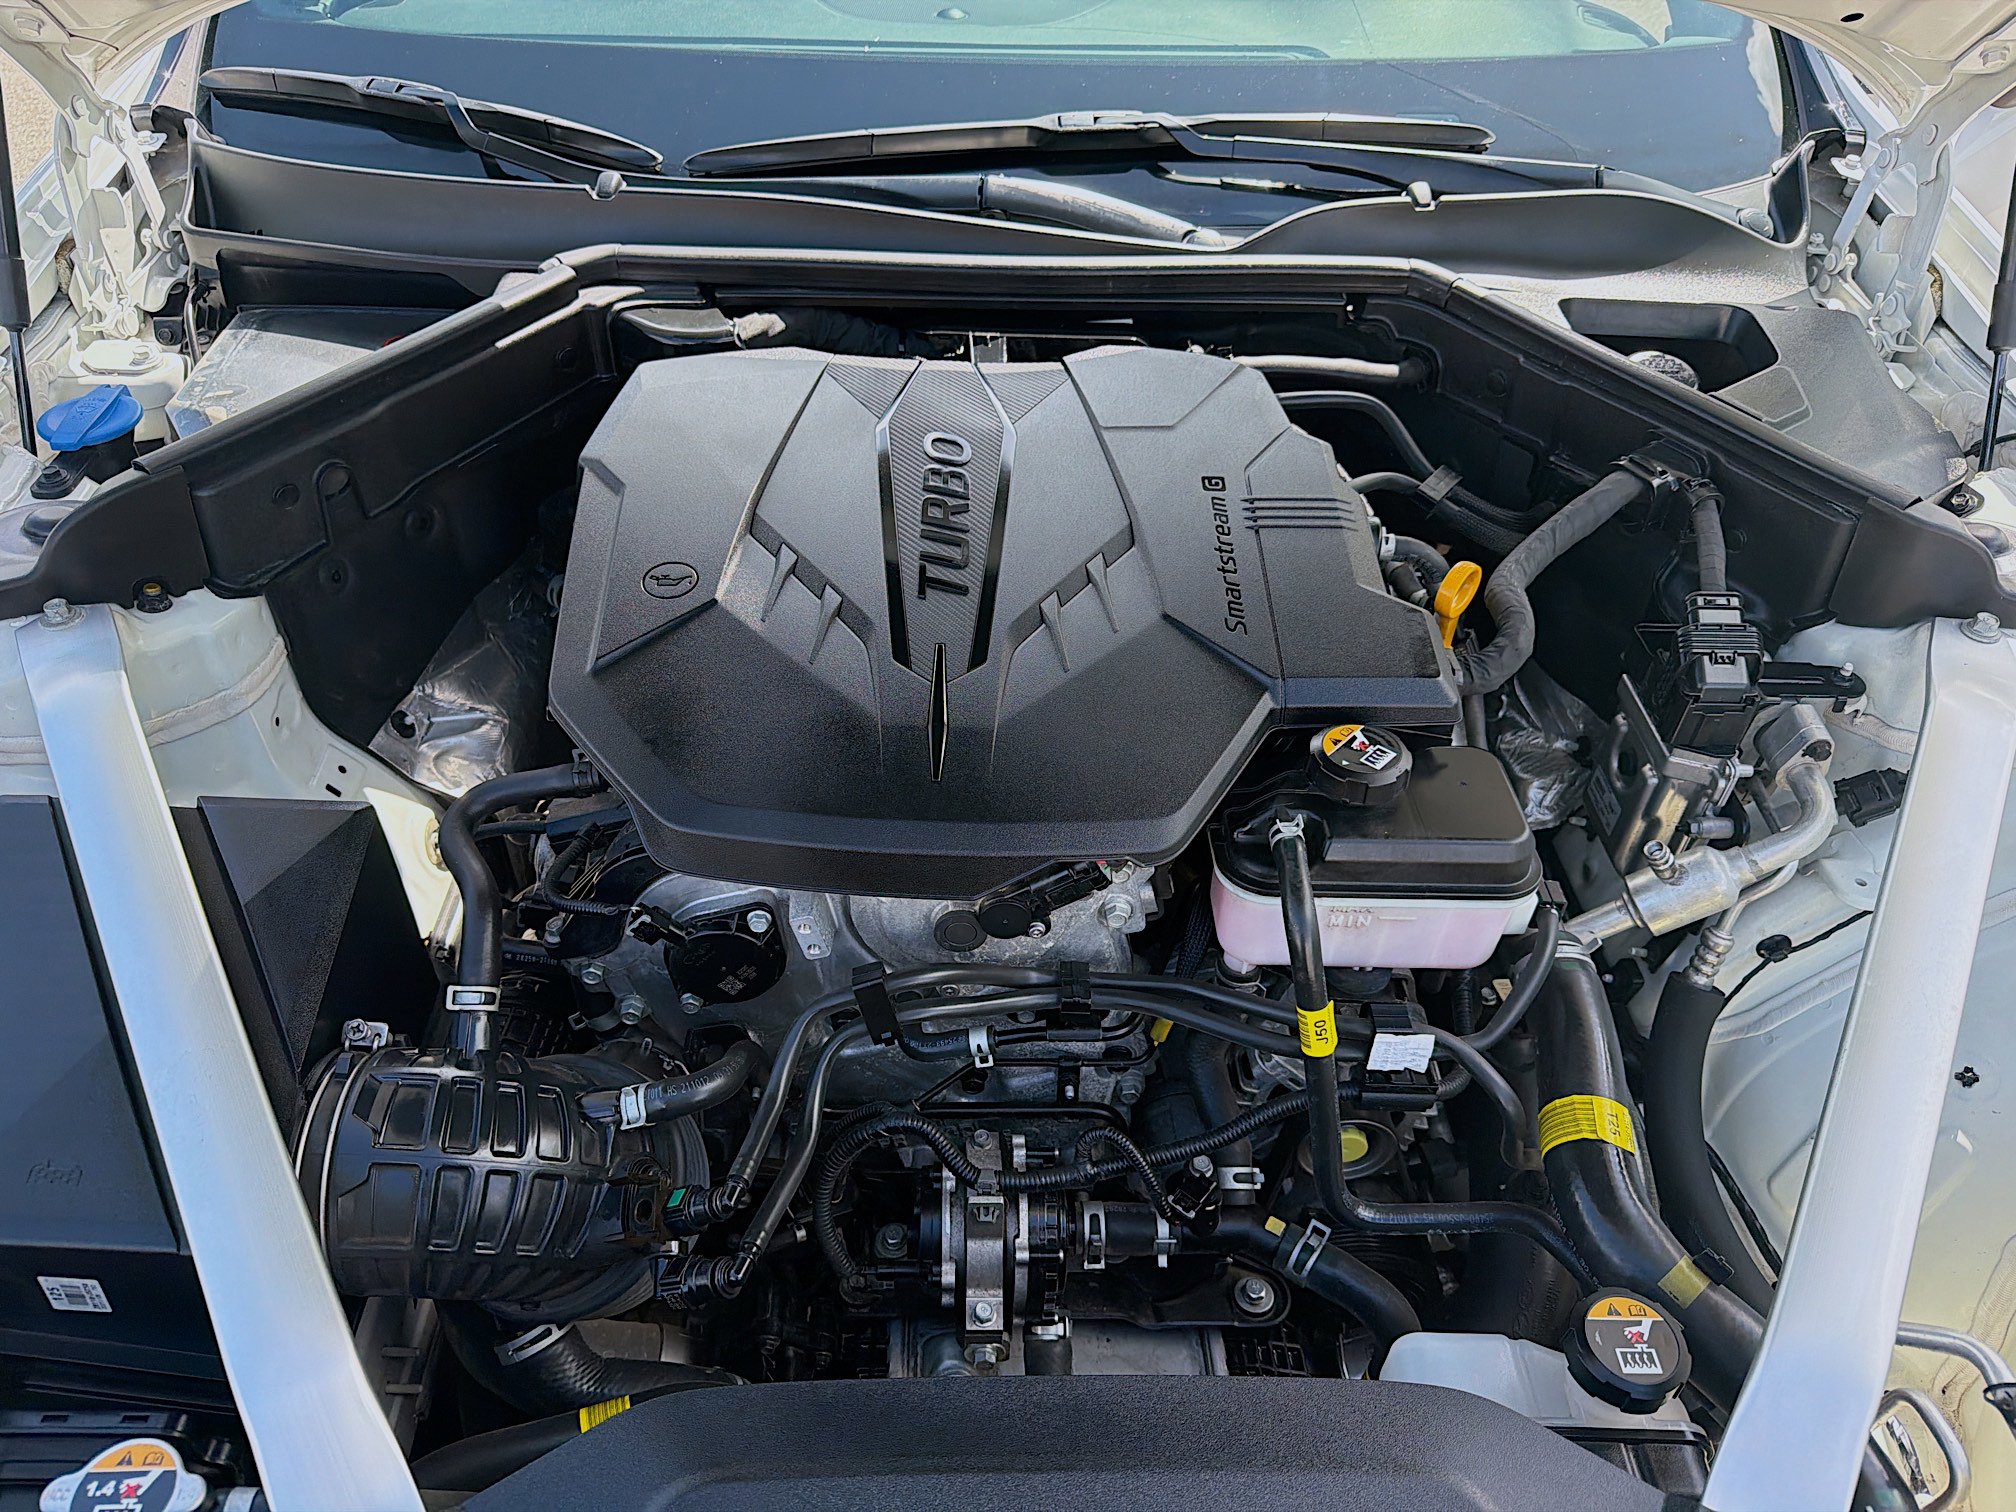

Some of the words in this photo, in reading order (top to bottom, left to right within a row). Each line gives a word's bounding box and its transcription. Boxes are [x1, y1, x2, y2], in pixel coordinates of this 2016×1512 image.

[918, 431, 973, 600] TURBO
[1211, 496, 1248, 636] Smartstream
[1328, 914, 1373, 928] MIN
[1314, 1020, 1329, 1044] J50
[667, 1085, 678, 1097] HS
[681, 1075, 712, 1094] 211012
[1607, 1112, 1621, 1137] T25
[86, 1480, 116, 1498] 1.4
